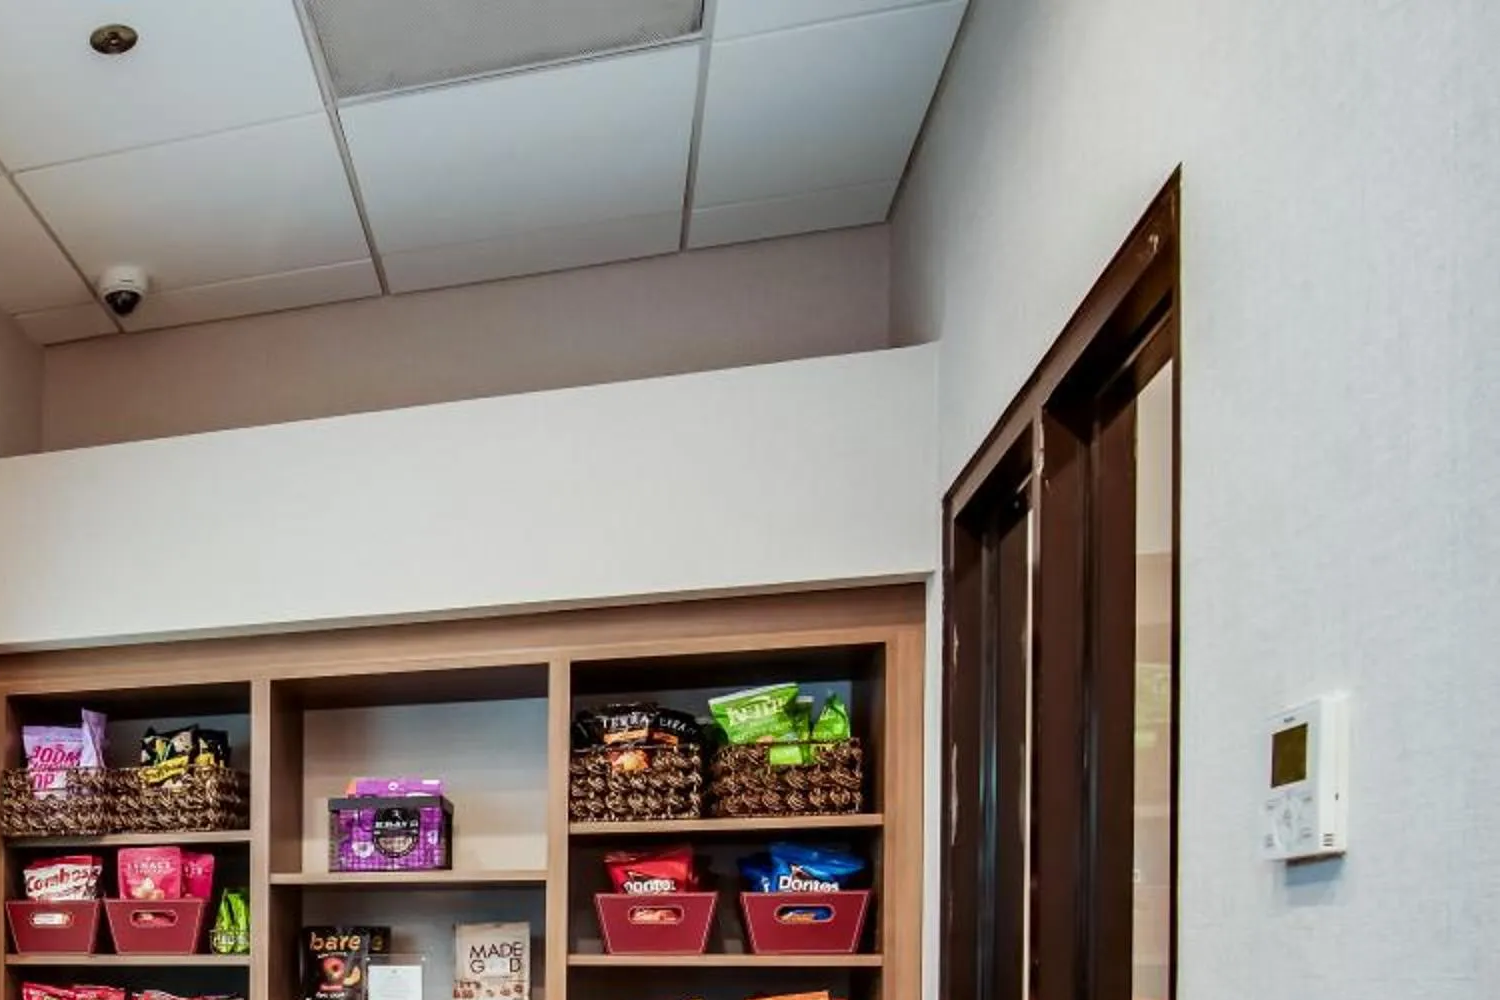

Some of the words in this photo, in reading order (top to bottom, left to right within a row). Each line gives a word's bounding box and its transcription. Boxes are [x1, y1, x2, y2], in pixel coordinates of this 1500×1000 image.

[778, 874, 841, 893] Doritos
[310, 931, 361, 951] bare
[469, 941, 524, 959] MADE
[469, 957, 522, 975] GD
